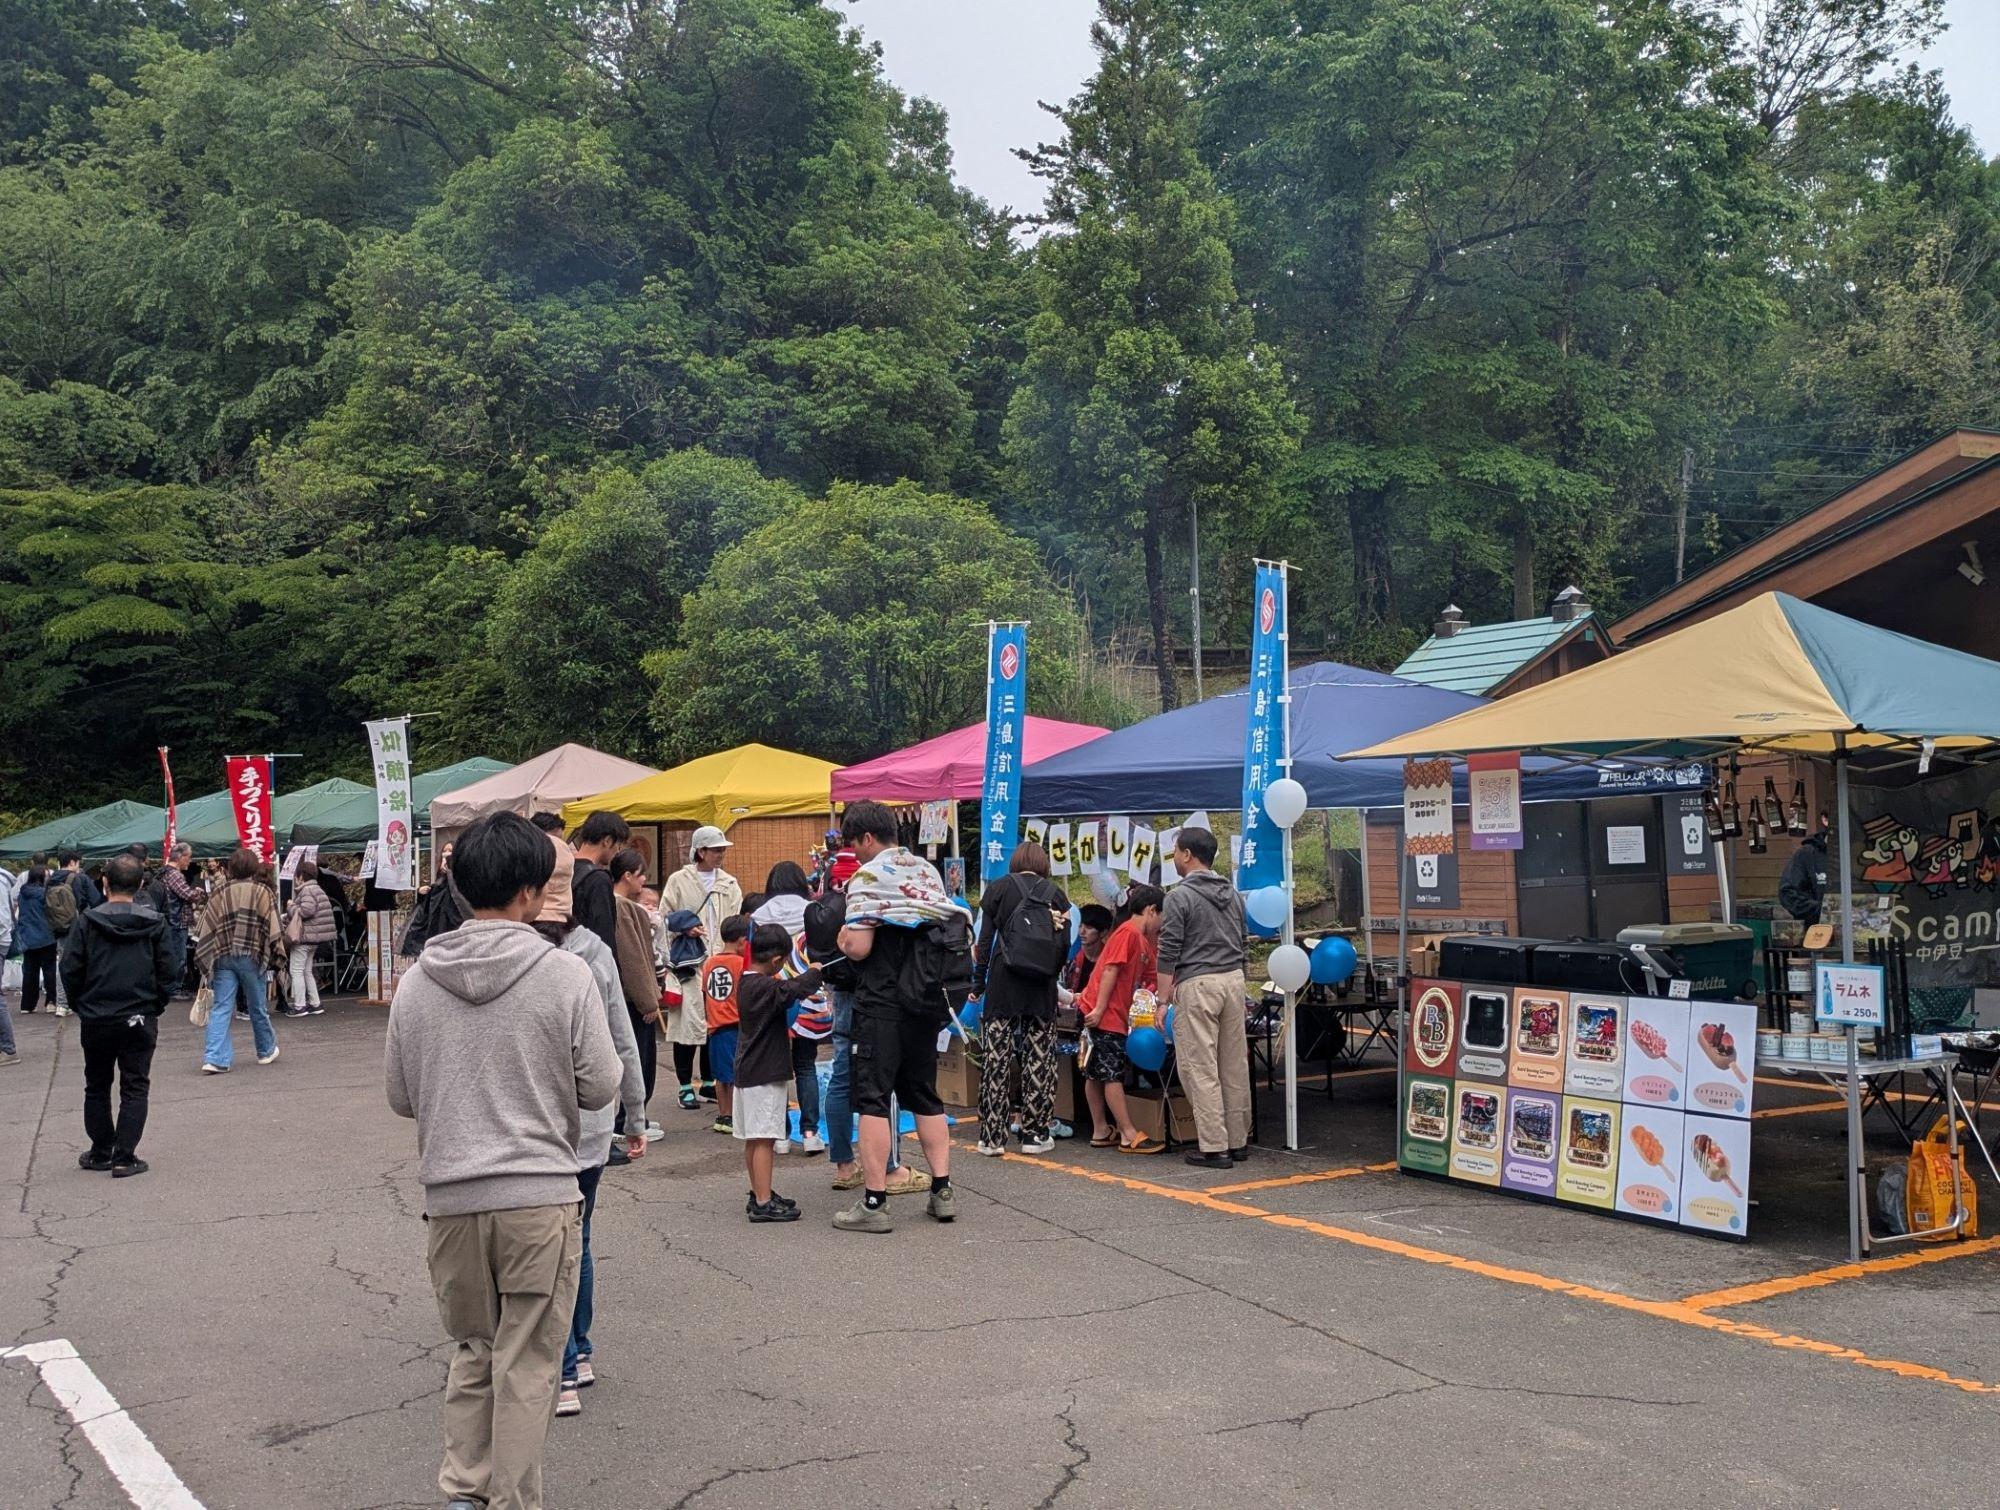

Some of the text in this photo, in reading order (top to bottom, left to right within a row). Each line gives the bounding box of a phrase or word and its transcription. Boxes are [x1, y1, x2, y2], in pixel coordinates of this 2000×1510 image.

[1242, 654, 1266, 868] 三島信用金庫
[1916, 943, 1964, 962] 中伊豆
[709, 971, 732, 999] 悟
[1835, 983, 1871, 998] ラムネ
[1854, 1007, 1878, 1018] 250円
